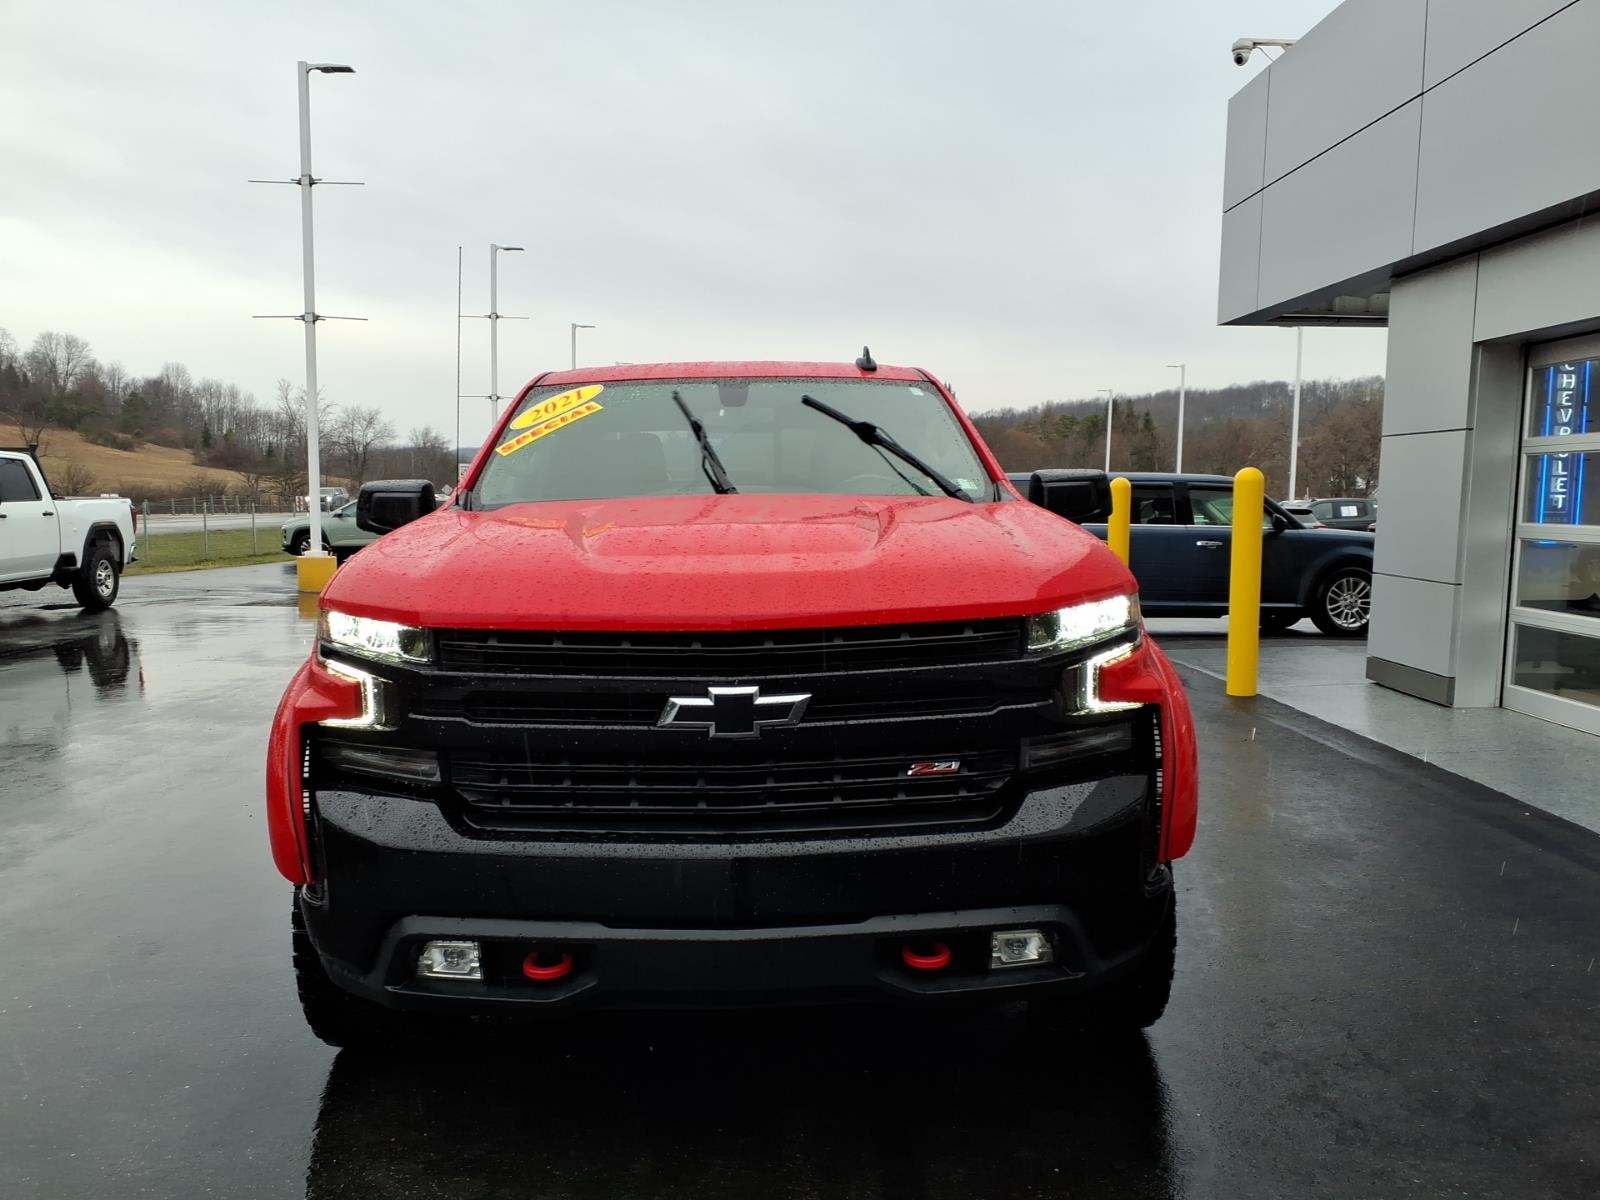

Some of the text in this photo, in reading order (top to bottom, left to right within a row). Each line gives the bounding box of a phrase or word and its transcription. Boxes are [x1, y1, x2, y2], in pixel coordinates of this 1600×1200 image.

[528, 389, 584, 422] 2021
[499, 402, 599, 454] SPECIAL
[1554, 363, 1576, 509] HEVRLET
[907, 760, 961, 776] Z71
